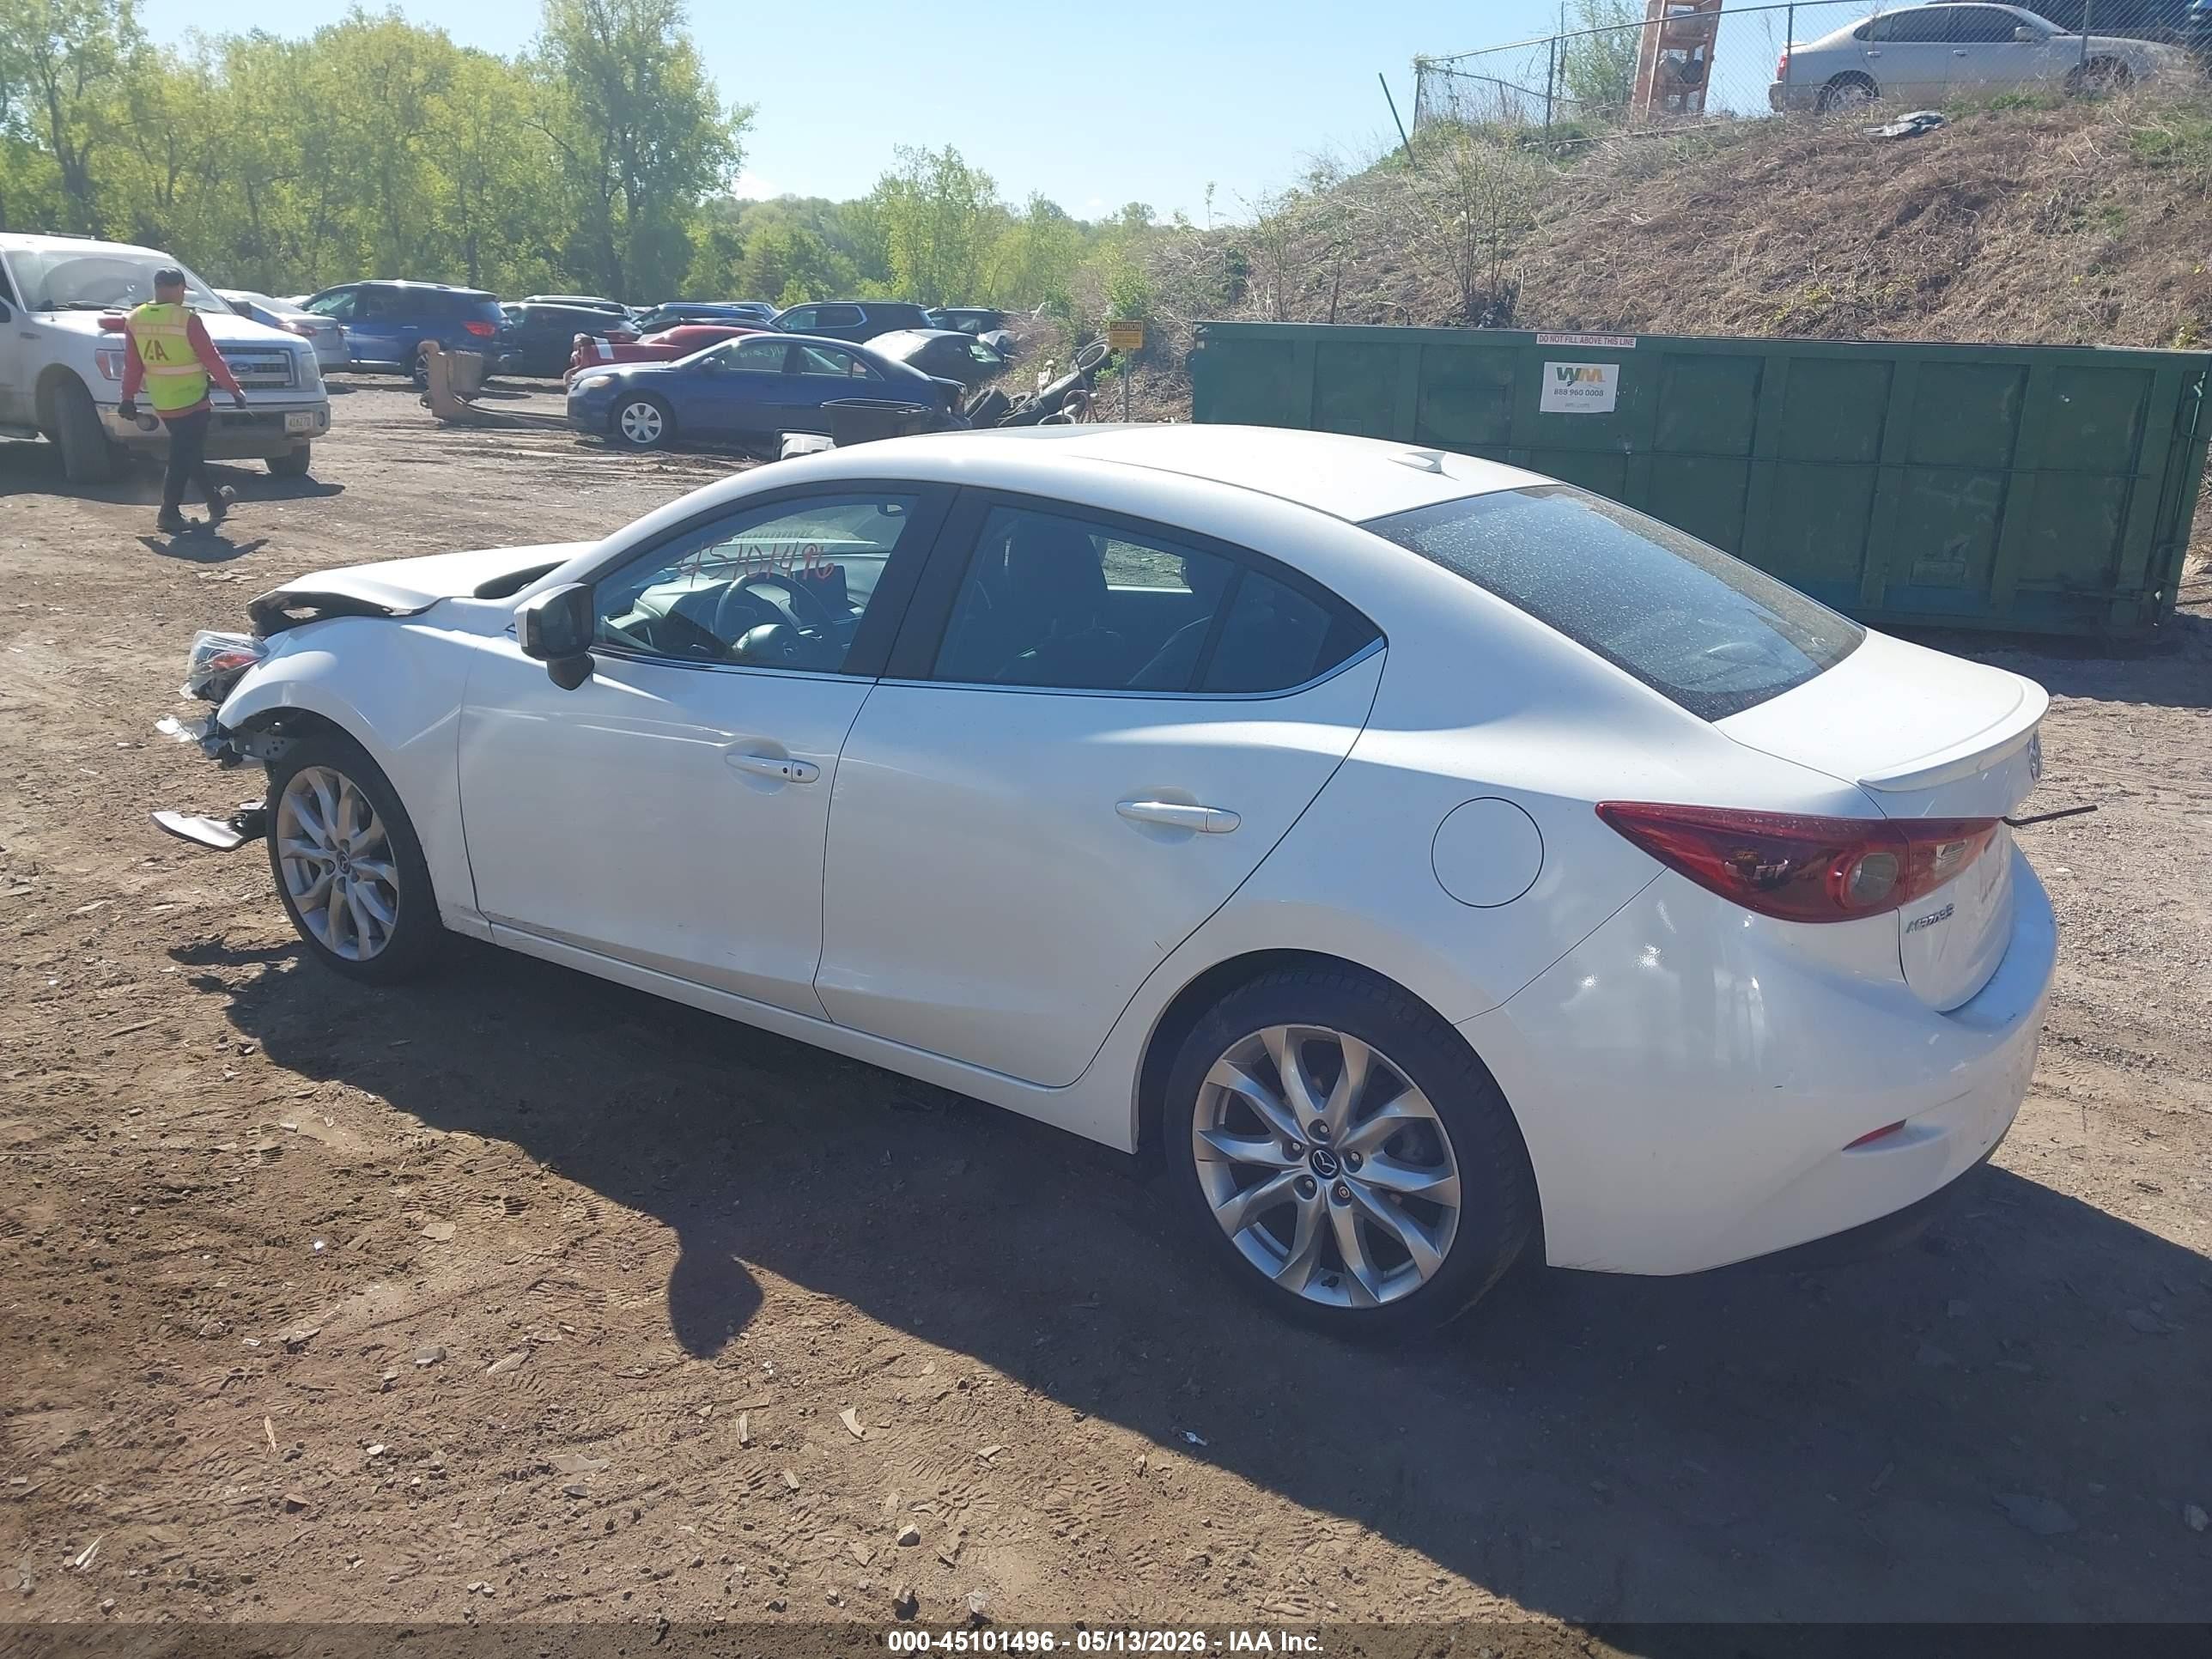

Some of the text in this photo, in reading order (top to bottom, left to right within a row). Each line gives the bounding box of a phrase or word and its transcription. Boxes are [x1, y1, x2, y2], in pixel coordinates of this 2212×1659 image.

[1111, 322, 1141, 331] CAUTION
[1538, 334, 1635, 347] DO NOT FILL ABOVE THIS LINE
[1556, 367, 1603, 382] WM
[1570, 388, 1583, 397] 960
[1585, 389, 1604, 398] 0008
[679, 541, 836, 589] 45101496
